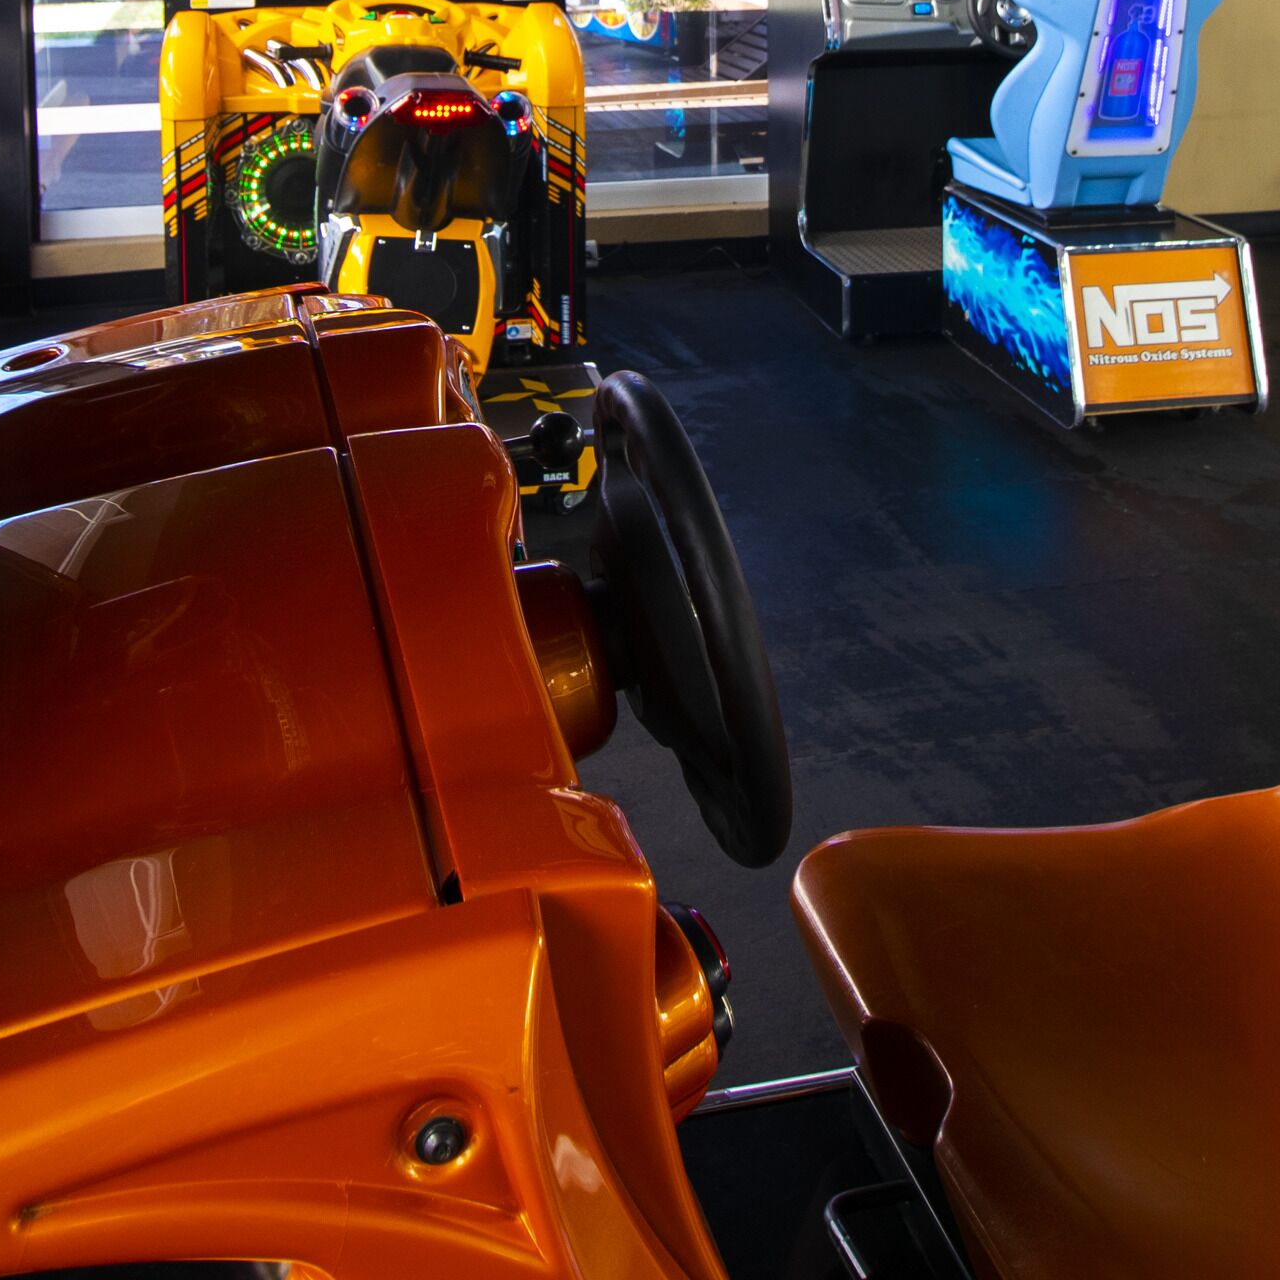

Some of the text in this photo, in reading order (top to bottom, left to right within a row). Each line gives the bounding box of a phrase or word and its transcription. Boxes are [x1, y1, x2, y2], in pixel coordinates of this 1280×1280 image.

[1081, 273, 1232, 348] NOS
[1088, 346, 1233, 366] Nitrous Oxide Systems
[543, 471, 570, 482] BACK
